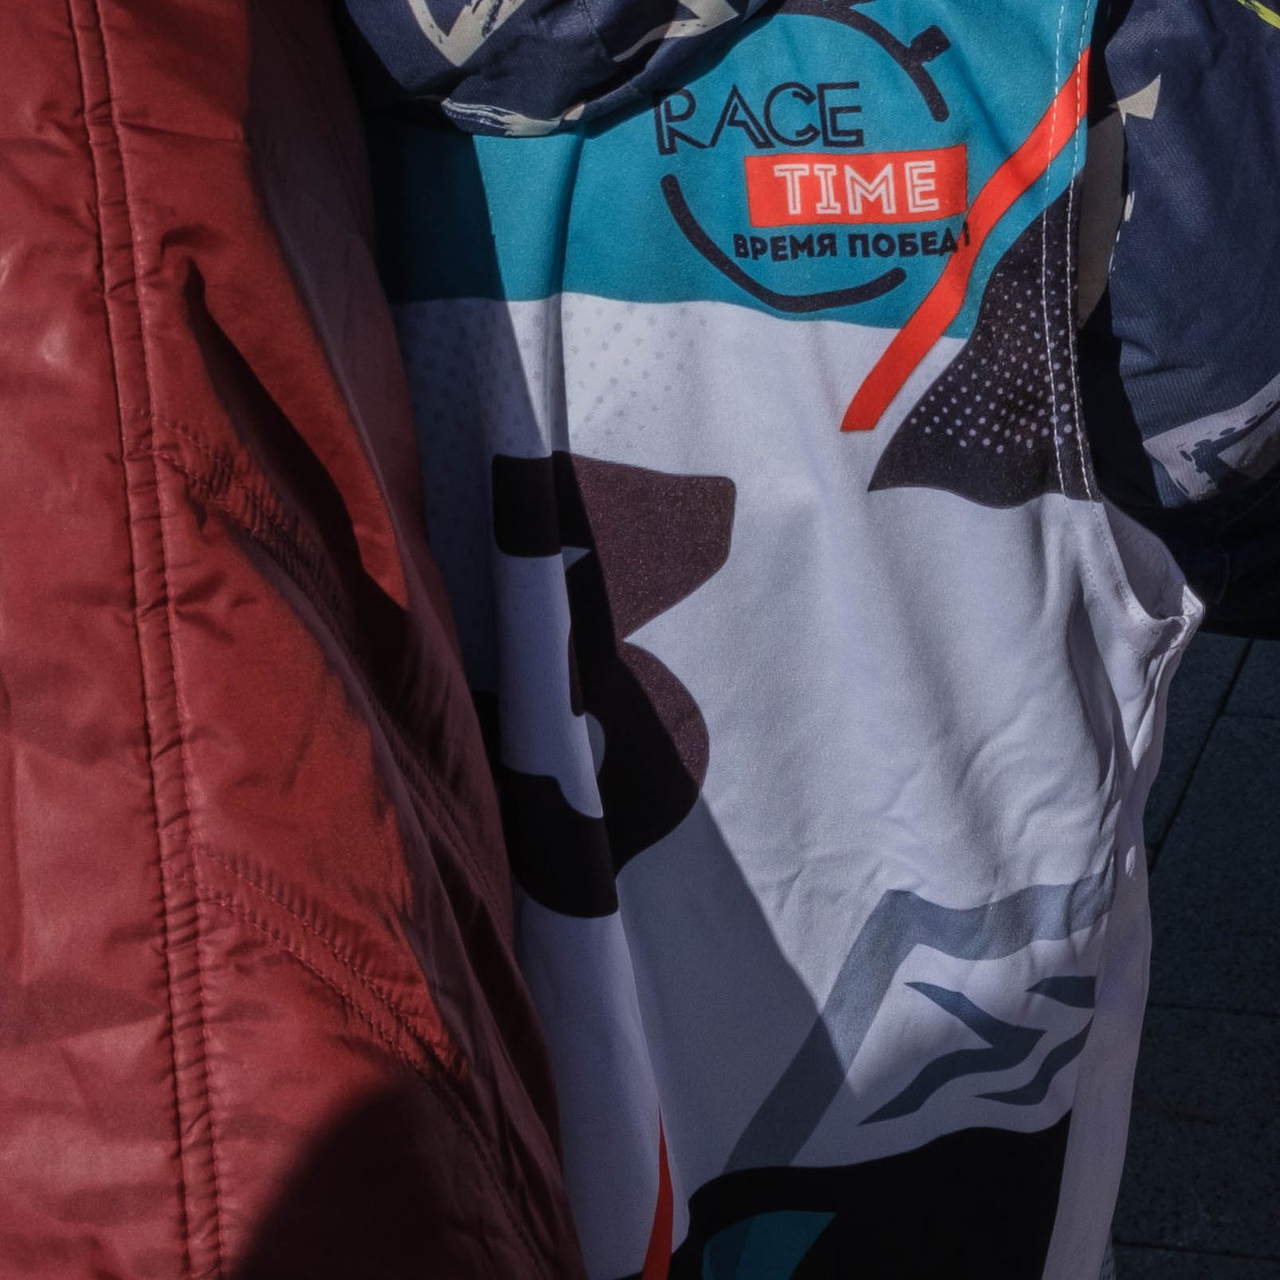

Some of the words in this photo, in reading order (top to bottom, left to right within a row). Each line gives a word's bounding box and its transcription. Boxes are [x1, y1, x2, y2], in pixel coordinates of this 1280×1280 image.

[652, 80, 865, 156] RACE
[773, 160, 939, 216] TIME
[733, 232, 838, 262] ВРЕМЯ
